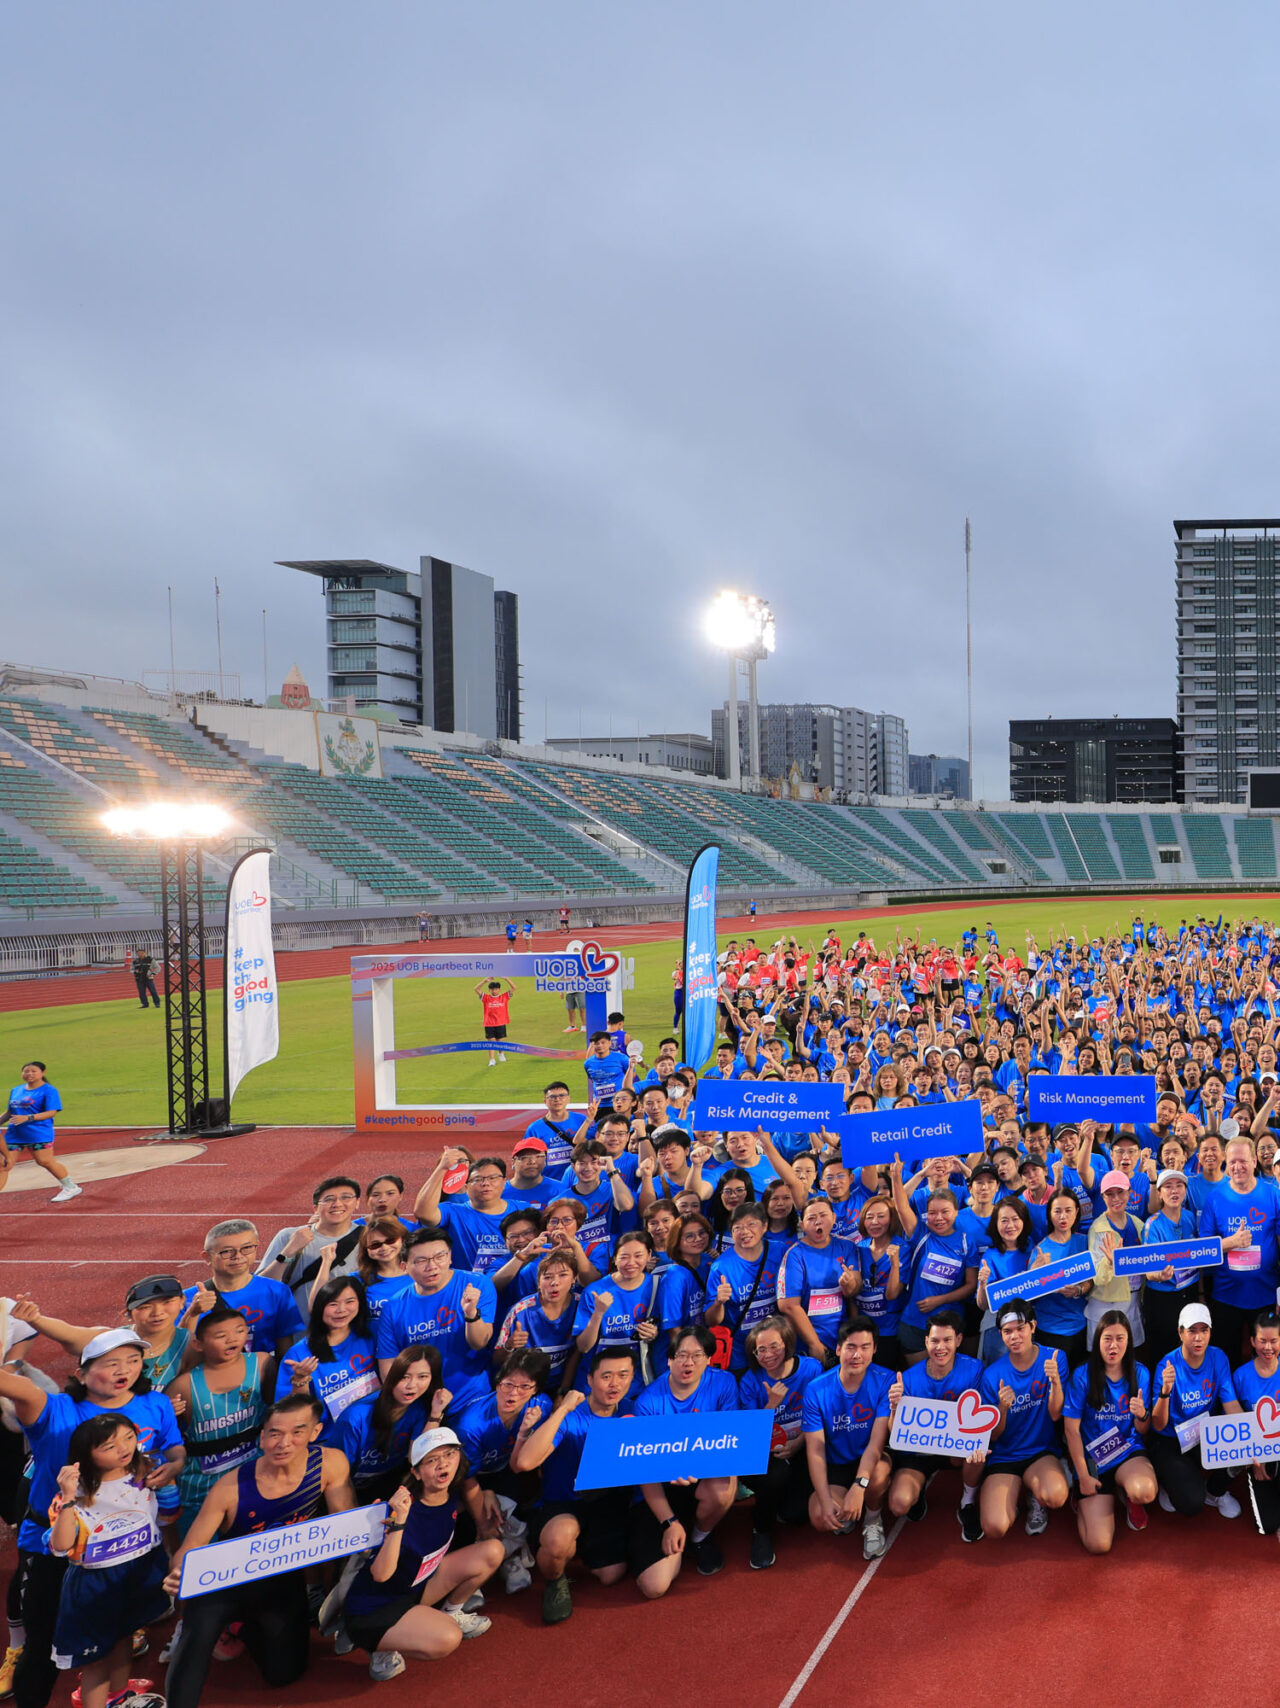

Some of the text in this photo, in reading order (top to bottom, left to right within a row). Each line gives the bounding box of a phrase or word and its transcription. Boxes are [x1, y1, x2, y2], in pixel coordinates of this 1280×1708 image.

[234, 947, 244, 960] #
[371, 960, 494, 972] 2025 UOB Heartbeat Run
[535, 959, 579, 977] UOB
[535, 978, 611, 992] Heartbeat
[743, 1092, 798, 1104] Credit &
[1039, 1093, 1146, 1106] Risk Management
[364, 1114, 476, 1126] #keepthegoodgoing
[707, 1106, 830, 1122] Risk Management
[871, 1123, 953, 1144] Retail Credit
[1228, 1216, 1247, 1225] UOB
[476, 1233, 499, 1243] UOB
[585, 1227, 606, 1238] 3691
[478, 1257, 490, 1265] M
[1118, 1246, 1218, 1267] #keepthegoodgoing
[928, 1262, 956, 1276] F 4127
[993, 1261, 1091, 1300] #keepthegoodgoing
[607, 1313, 630, 1326] UOB
[745, 1306, 776, 1320] F 3425
[408, 1319, 436, 1335] UOB
[318, 1369, 349, 1388] UOB
[1181, 1390, 1201, 1402] UOB
[901, 1405, 948, 1429] UOB
[1094, 1411, 1131, 1422] Heartbeat
[896, 1429, 982, 1452] Heartbeat
[1205, 1422, 1251, 1445] UOB
[619, 1435, 738, 1457] Internal Audit
[1094, 1436, 1122, 1459] F 3792
[204, 1453, 218, 1465] M
[92, 1530, 148, 1557] F 4420
[250, 1525, 331, 1556] Right By
[198, 1532, 370, 1587] Our Communities
